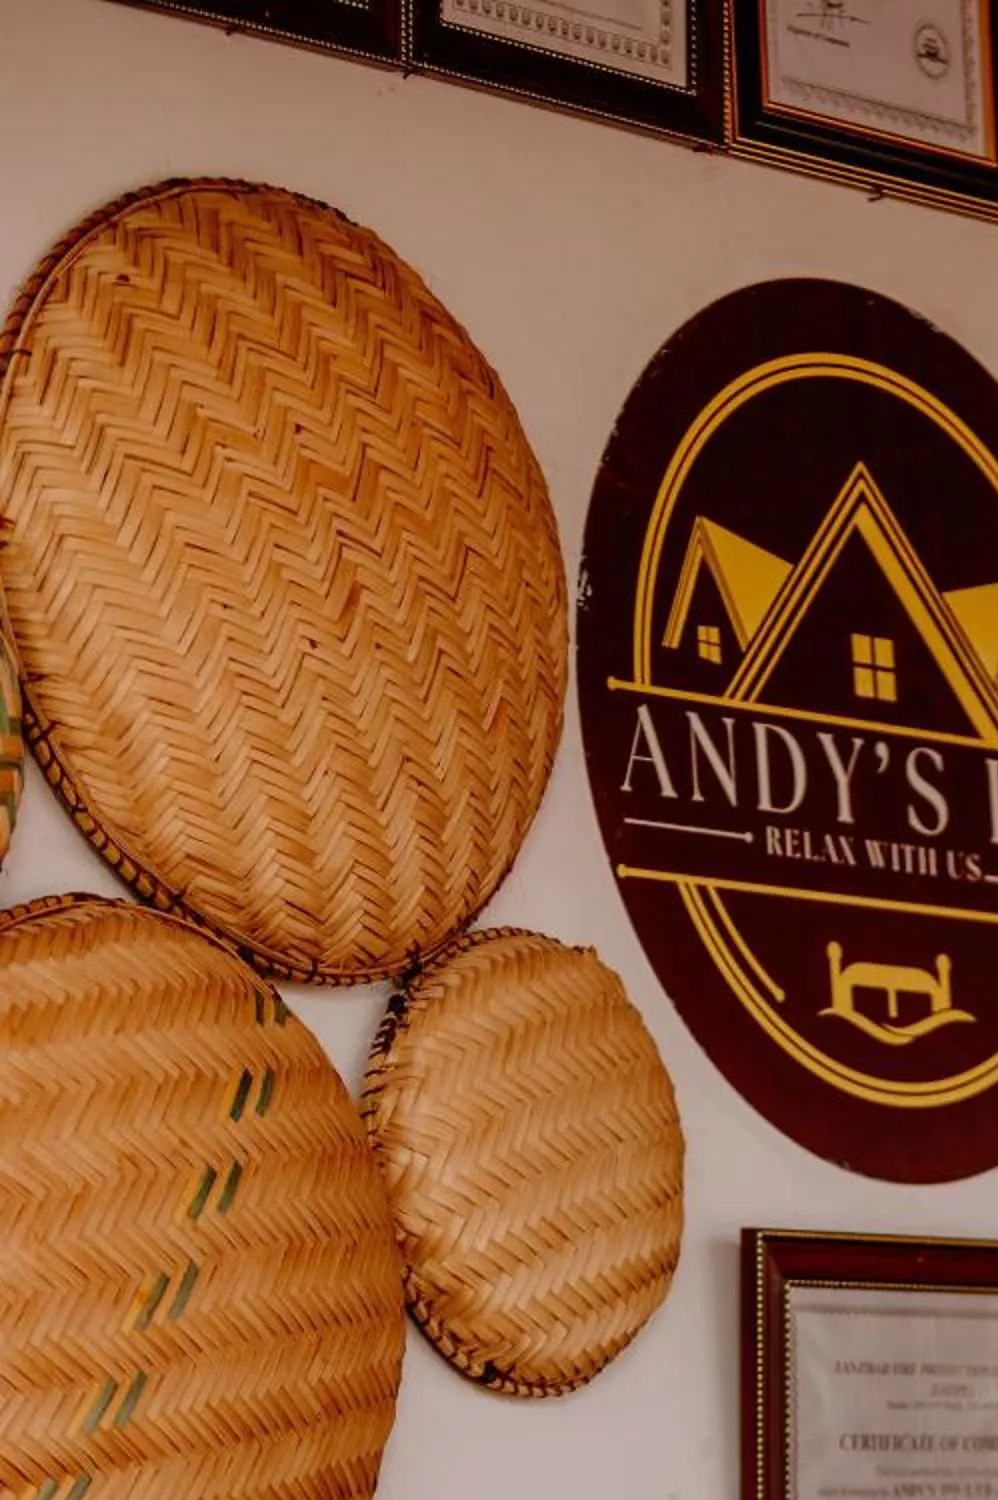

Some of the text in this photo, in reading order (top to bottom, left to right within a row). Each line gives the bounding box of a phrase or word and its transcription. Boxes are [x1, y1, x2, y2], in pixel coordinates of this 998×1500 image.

[620, 703, 949, 836] ANDY'S
[765, 825, 983, 882] RELAX WITH US
[839, 1432, 933, 1452] CERTIFICATE
